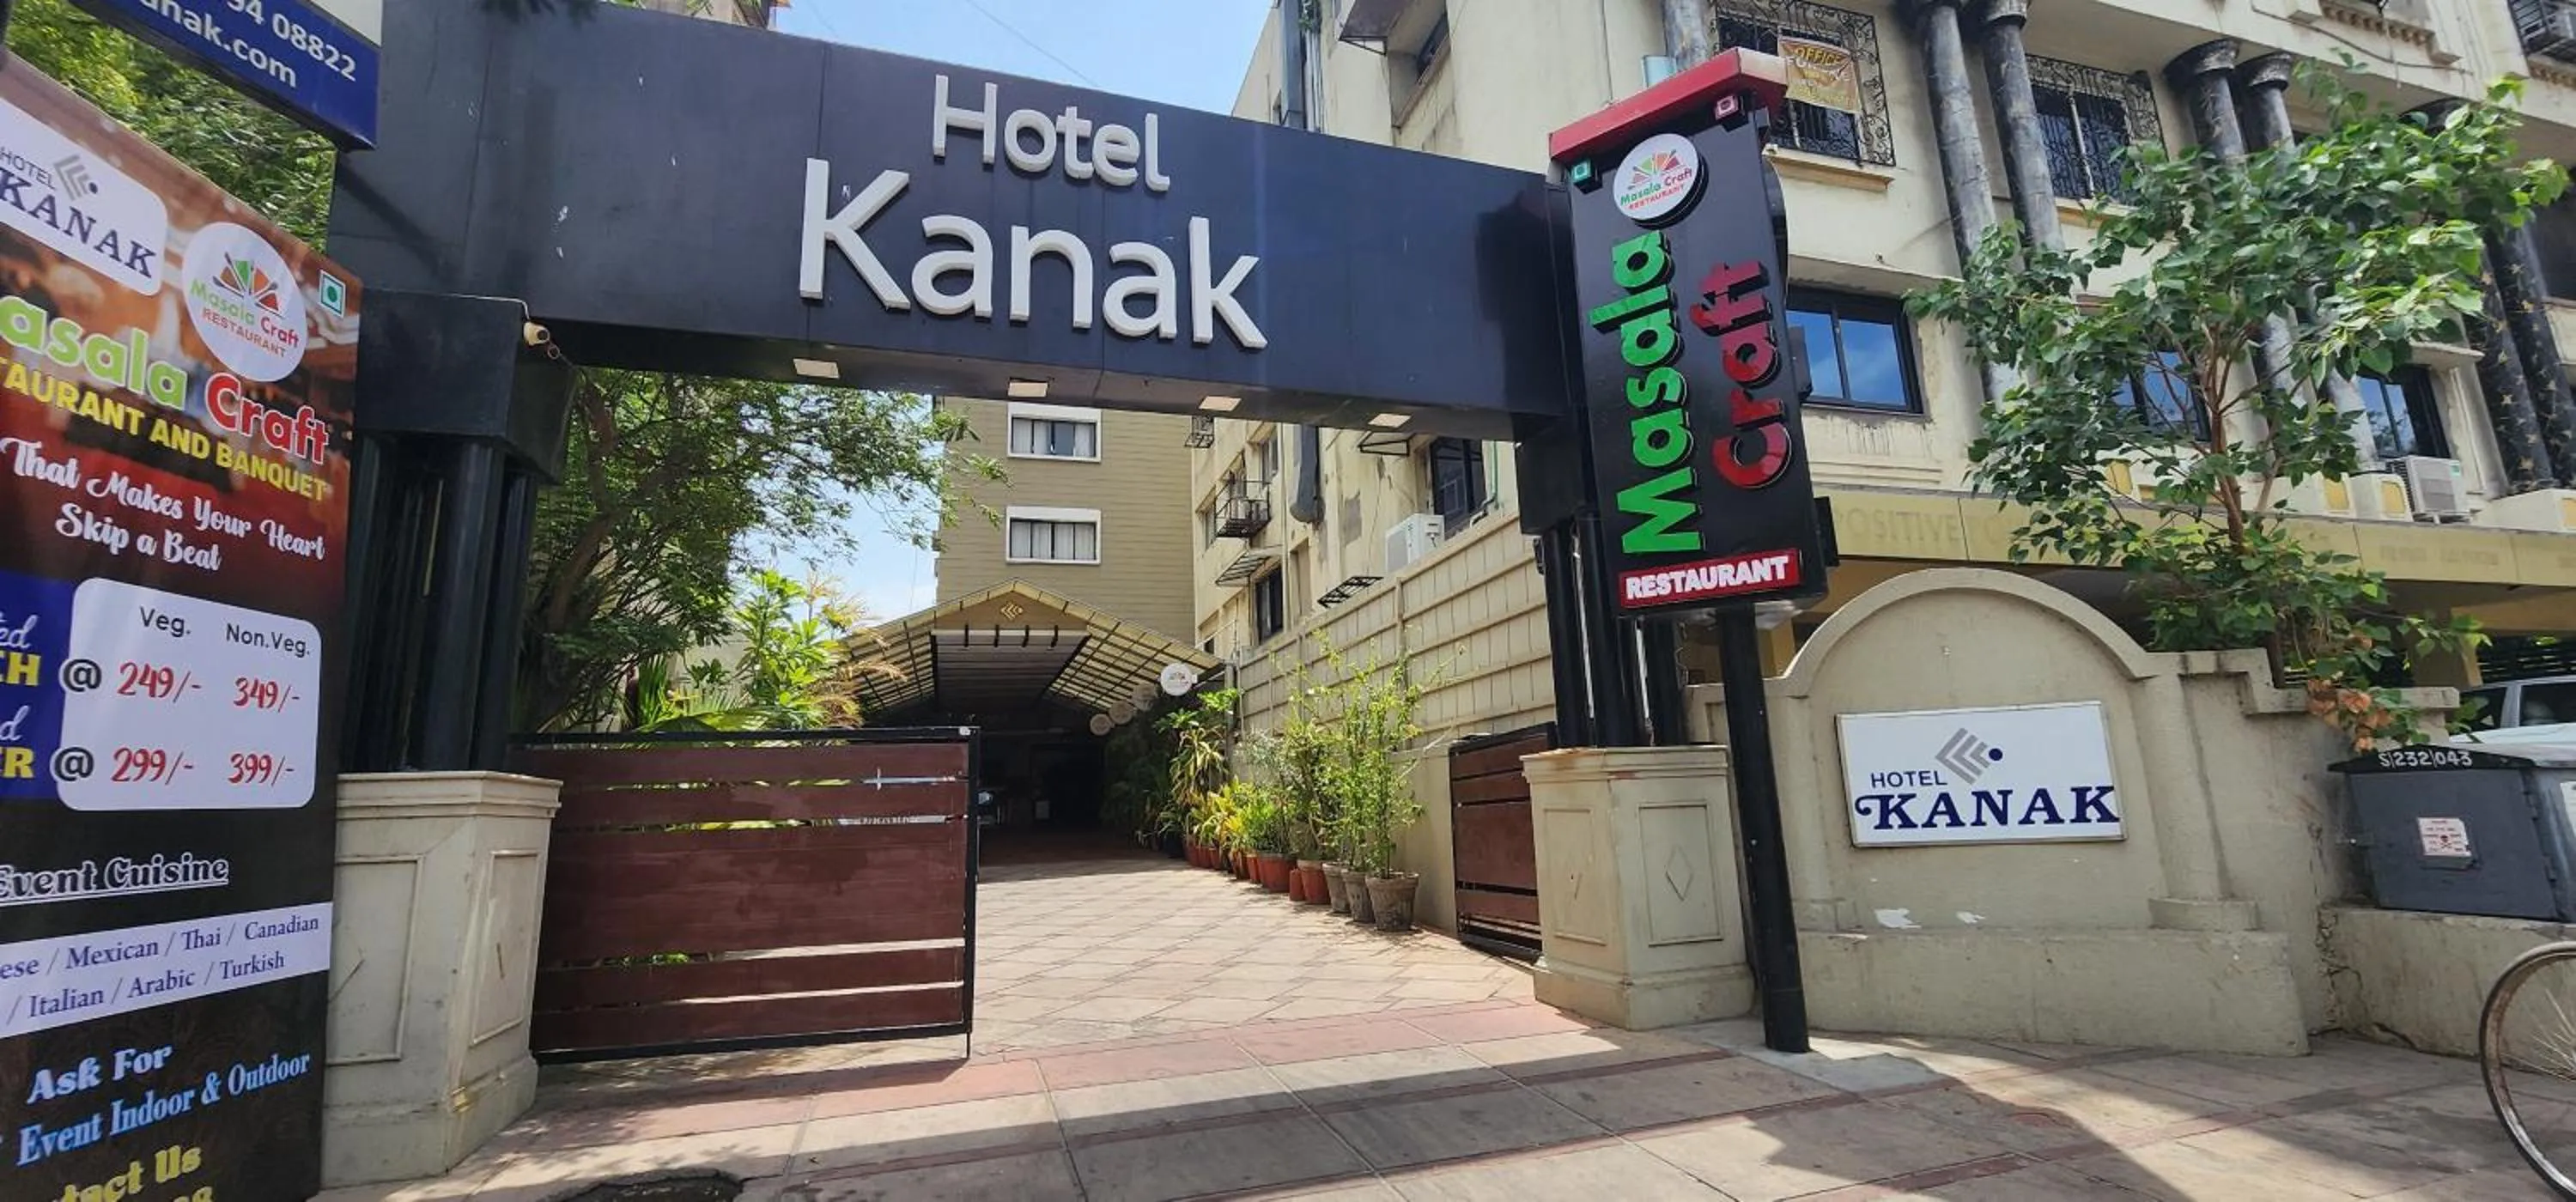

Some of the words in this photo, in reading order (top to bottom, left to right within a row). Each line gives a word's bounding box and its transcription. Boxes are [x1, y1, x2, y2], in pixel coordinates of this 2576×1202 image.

[272, 13, 356, 82] 08822
[933, 74, 1170, 192] Hotel
[0, 146, 56, 191] HOTEL
[1620, 181, 1662, 206] Masala
[1664, 167, 1693, 187] Craft
[1628, 184, 1686, 210] RESTAURANT
[0, 167, 156, 278] KANAK
[799, 157, 1268, 349] Kanak
[191, 277, 255, 325] Masala
[260, 316, 299, 347] Craft
[202, 307, 287, 358] RESTAURANT
[1589, 230, 1704, 554] Masala
[1690, 261, 1791, 489] Craft
[204, 372, 328, 464] Craft
[149, 417, 210, 460] AND
[216, 443, 328, 502] BANQUET
[0, 437, 81, 489] That
[87, 470, 183, 520] Makes
[194, 495, 252, 537] Your
[259, 519, 325, 560] Heart
[1838, 507, 1961, 543] OSITIVE
[55, 502, 129, 555] Skip
[137, 534, 158, 555] a
[163, 529, 222, 571] Beat
[1625, 555, 1789, 600] RESTAURANT
[140, 606, 191, 637] Veg.
[225, 622, 311, 659] Non.Veg.
[63, 659, 102, 693] @
[117, 662, 201, 703] 249/-
[233, 677, 301, 713] 349/-
[53, 746, 94, 783] @
[111, 747, 195, 786] 299/-
[228, 753, 295, 787] 399/-
[1871, 770, 1948, 788] HOTEL
[1854, 786, 2121, 830] KANAK
[0, 859, 97, 899] Event
[103, 852, 230, 889] Cuisine
[0, 959, 39, 980] ese
[65, 938, 159, 970] Mexican
[181, 927, 222, 951] Thai
[245, 914, 319, 941] Canadian
[29, 987, 104, 1018] Italian
[128, 969, 196, 999] Arabic
[221, 950, 285, 980] Turkish
[27, 1057, 101, 1105] Ask
[114, 1044, 173, 1081] For
[16, 1113, 103, 1167] Event
[109, 1090, 196, 1137] Indoor
[201, 1071, 223, 1106] &
[228, 1053, 311, 1096] Outdoor
[155, 1144, 203, 1184] Us
